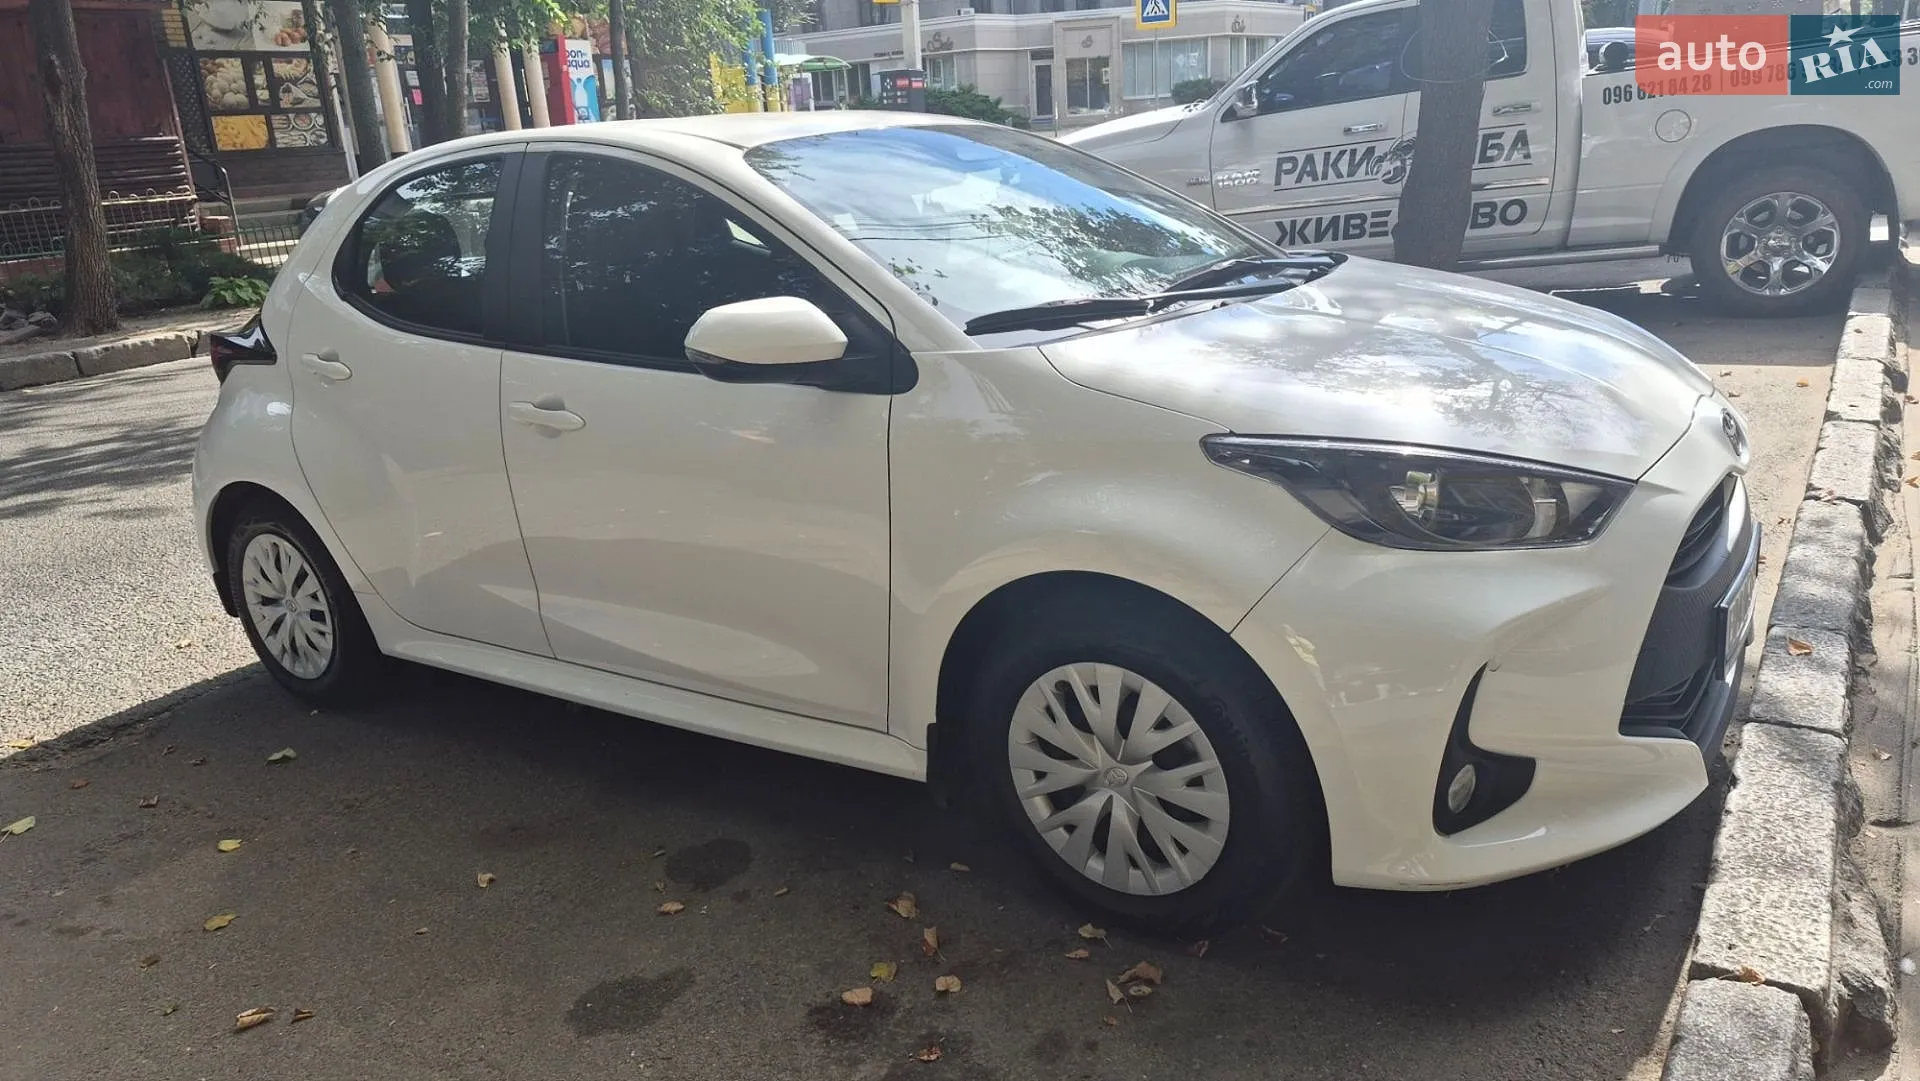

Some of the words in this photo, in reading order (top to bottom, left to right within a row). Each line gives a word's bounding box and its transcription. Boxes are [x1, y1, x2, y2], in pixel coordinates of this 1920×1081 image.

[1602, 84, 1633, 105] 096
[1692, 74, 1712, 93] 28
[1274, 145, 1377, 187] РАКИ
[1275, 209, 1393, 246] ЖИВЕ
